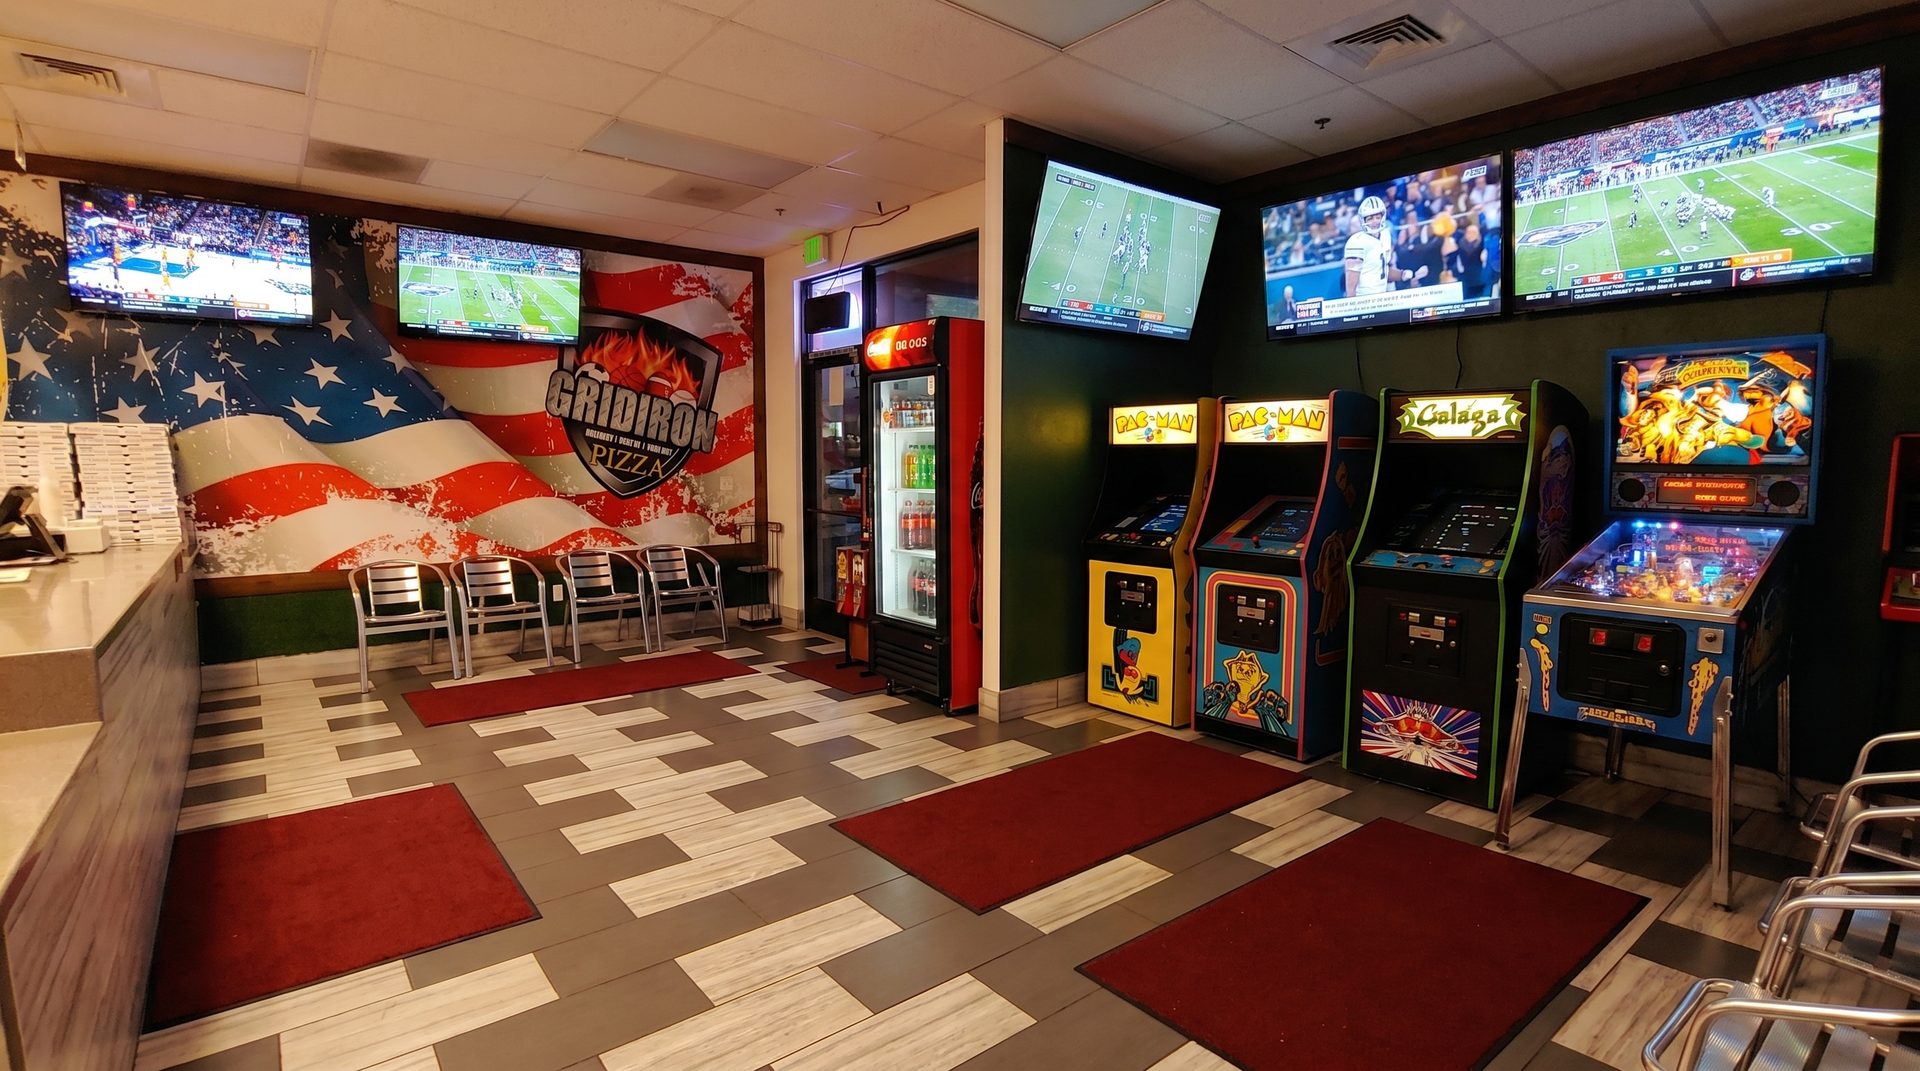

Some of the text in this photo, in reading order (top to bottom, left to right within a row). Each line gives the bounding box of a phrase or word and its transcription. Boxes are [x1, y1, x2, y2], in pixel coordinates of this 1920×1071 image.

[546, 369, 718, 454] GRIDIRON
[1115, 411, 1194, 433] PAC-MAN
[1229, 407, 1325, 432] PAC-MAN
[1416, 402, 1502, 437] Galaga
[590, 443, 663, 479] PIZZA
